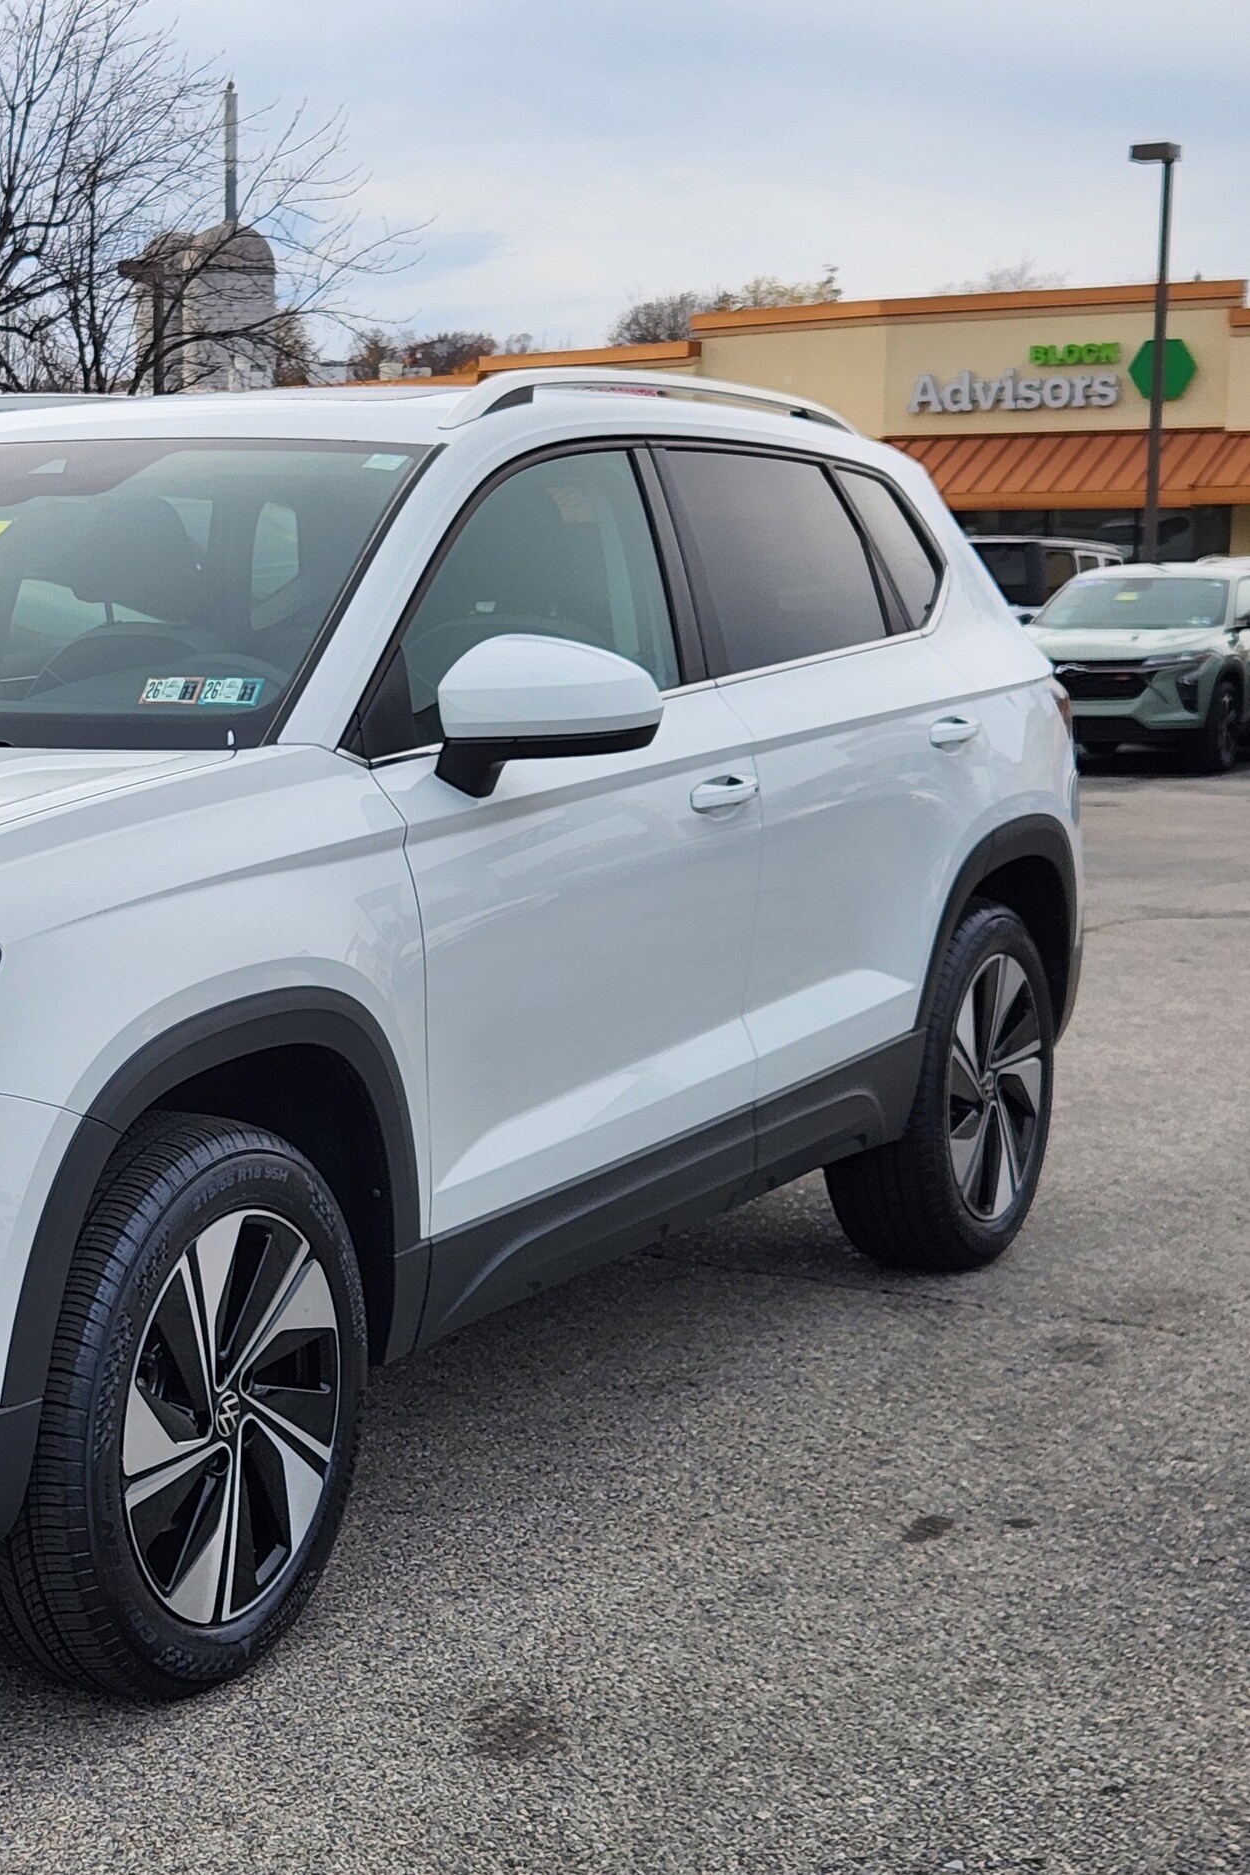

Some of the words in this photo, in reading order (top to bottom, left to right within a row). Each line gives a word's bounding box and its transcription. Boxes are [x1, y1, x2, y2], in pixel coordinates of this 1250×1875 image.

[1030, 343, 1120, 365] BLOCK
[907, 368, 1121, 414] Advisors
[145, 681, 163, 699] 26
[204, 681, 221, 699] 26
[238, 1165, 262, 1183] R18
[264, 1167, 289, 1182] 95H
